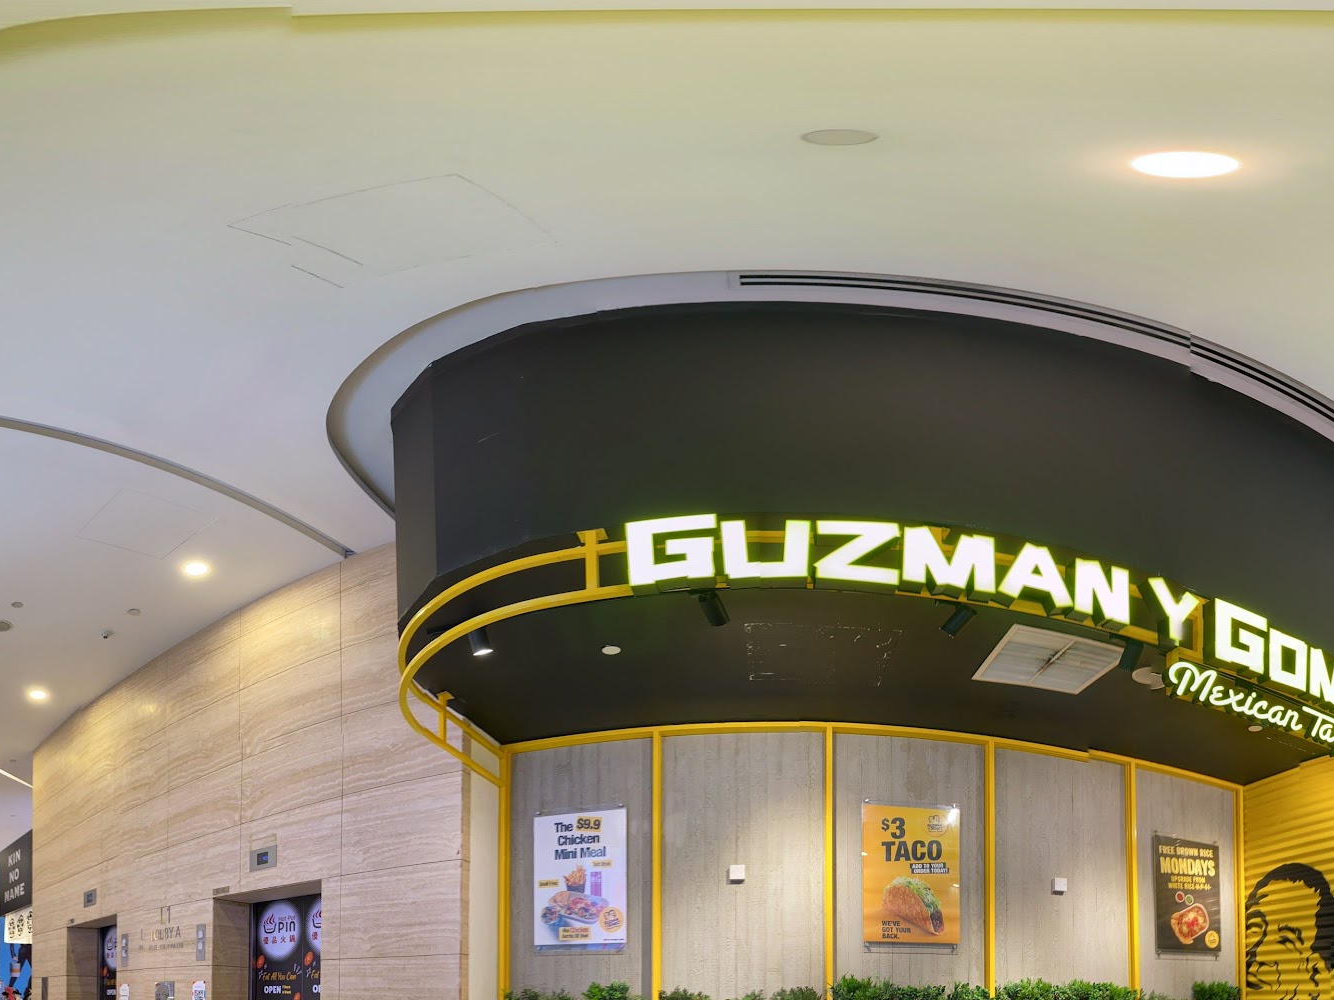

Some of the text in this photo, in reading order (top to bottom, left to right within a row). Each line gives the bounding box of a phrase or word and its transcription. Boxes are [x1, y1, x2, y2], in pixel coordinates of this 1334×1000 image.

[624, 512, 1132, 627] GUZMAN
[1147, 574, 1202, 643] Y
[1167, 659, 1304, 734] Mexican
[553, 818, 601, 833] The $9.9
[881, 817, 906, 840] $3
[557, 833, 600, 846] Chicken
[8, 849, 21, 867] KIN
[554, 846, 606, 860] Mini Meal
[881, 840, 943, 862] TACO
[1158, 845, 1214, 858] FREE BROWN RICE
[1160, 856, 1216, 877] MONDAYS
[8, 868, 19, 884] NO
[263, 985, 281, 994] OPEN
